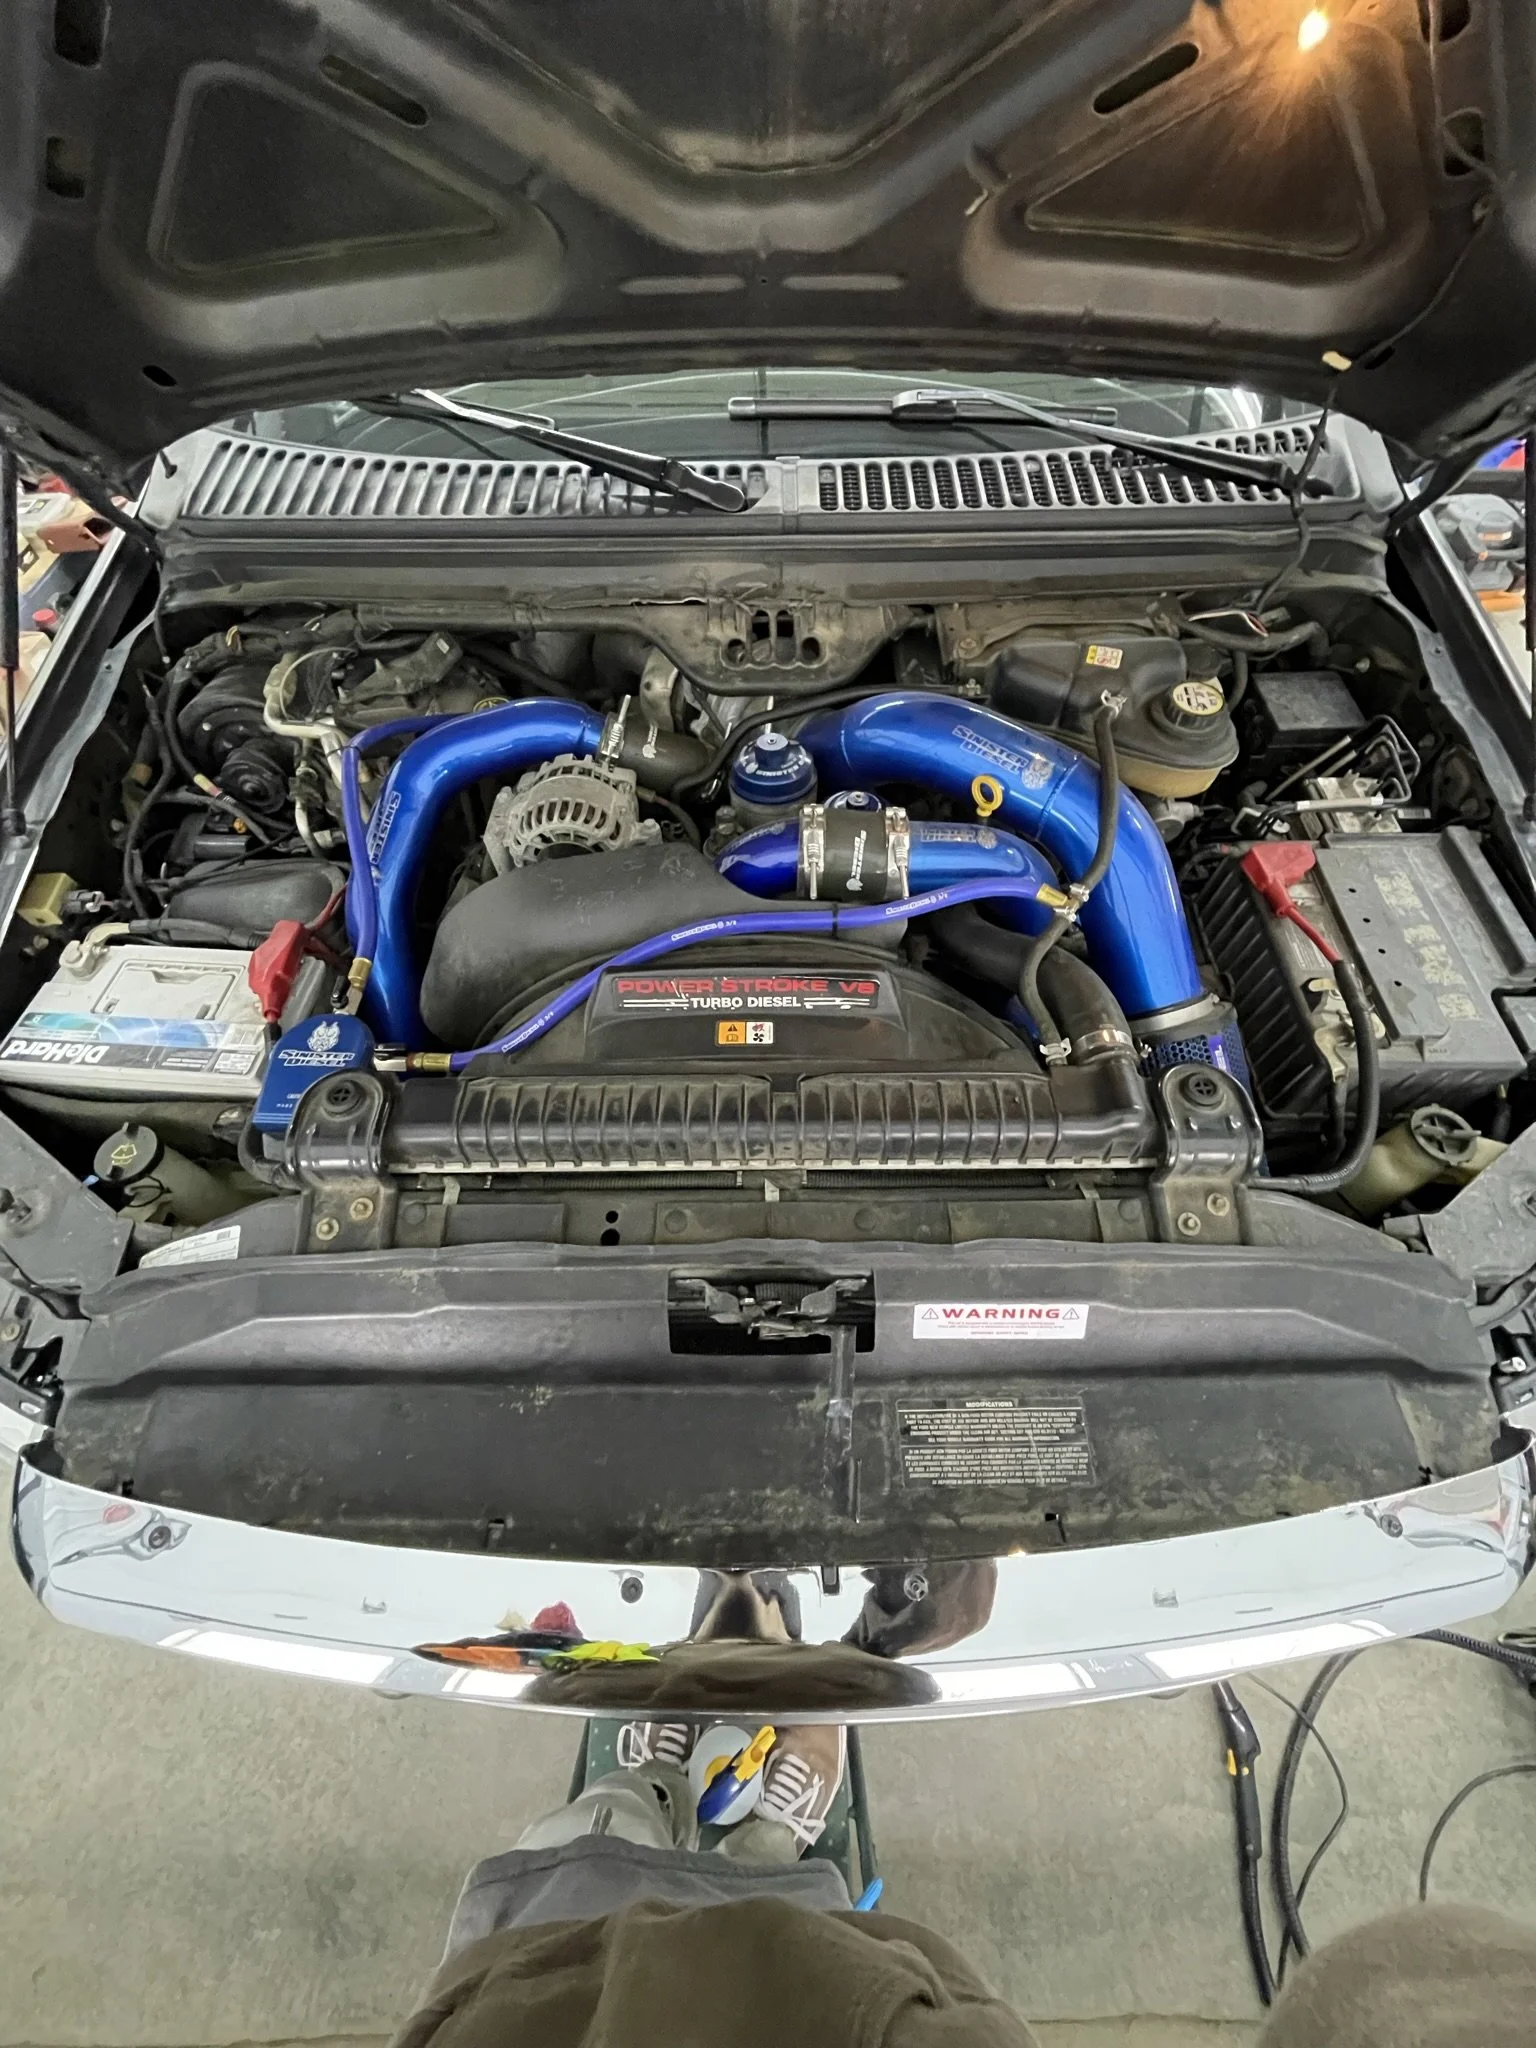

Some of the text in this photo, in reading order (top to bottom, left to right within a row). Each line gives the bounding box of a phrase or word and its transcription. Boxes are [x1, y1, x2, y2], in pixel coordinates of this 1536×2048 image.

[952, 724, 1029, 768] SINISTER
[370, 791, 401, 865] SINISTER
[617, 979, 714, 994] POWER
[721, 978, 829, 993] STROKE
[690, 996, 802, 1009] TURBO DIESEL
[1, 1040, 110, 1065] DieHard
[278, 1049, 356, 1061] SINISTER
[283, 1057, 346, 1068] DIESEL
[942, 1308, 1061, 1319] WARNING
